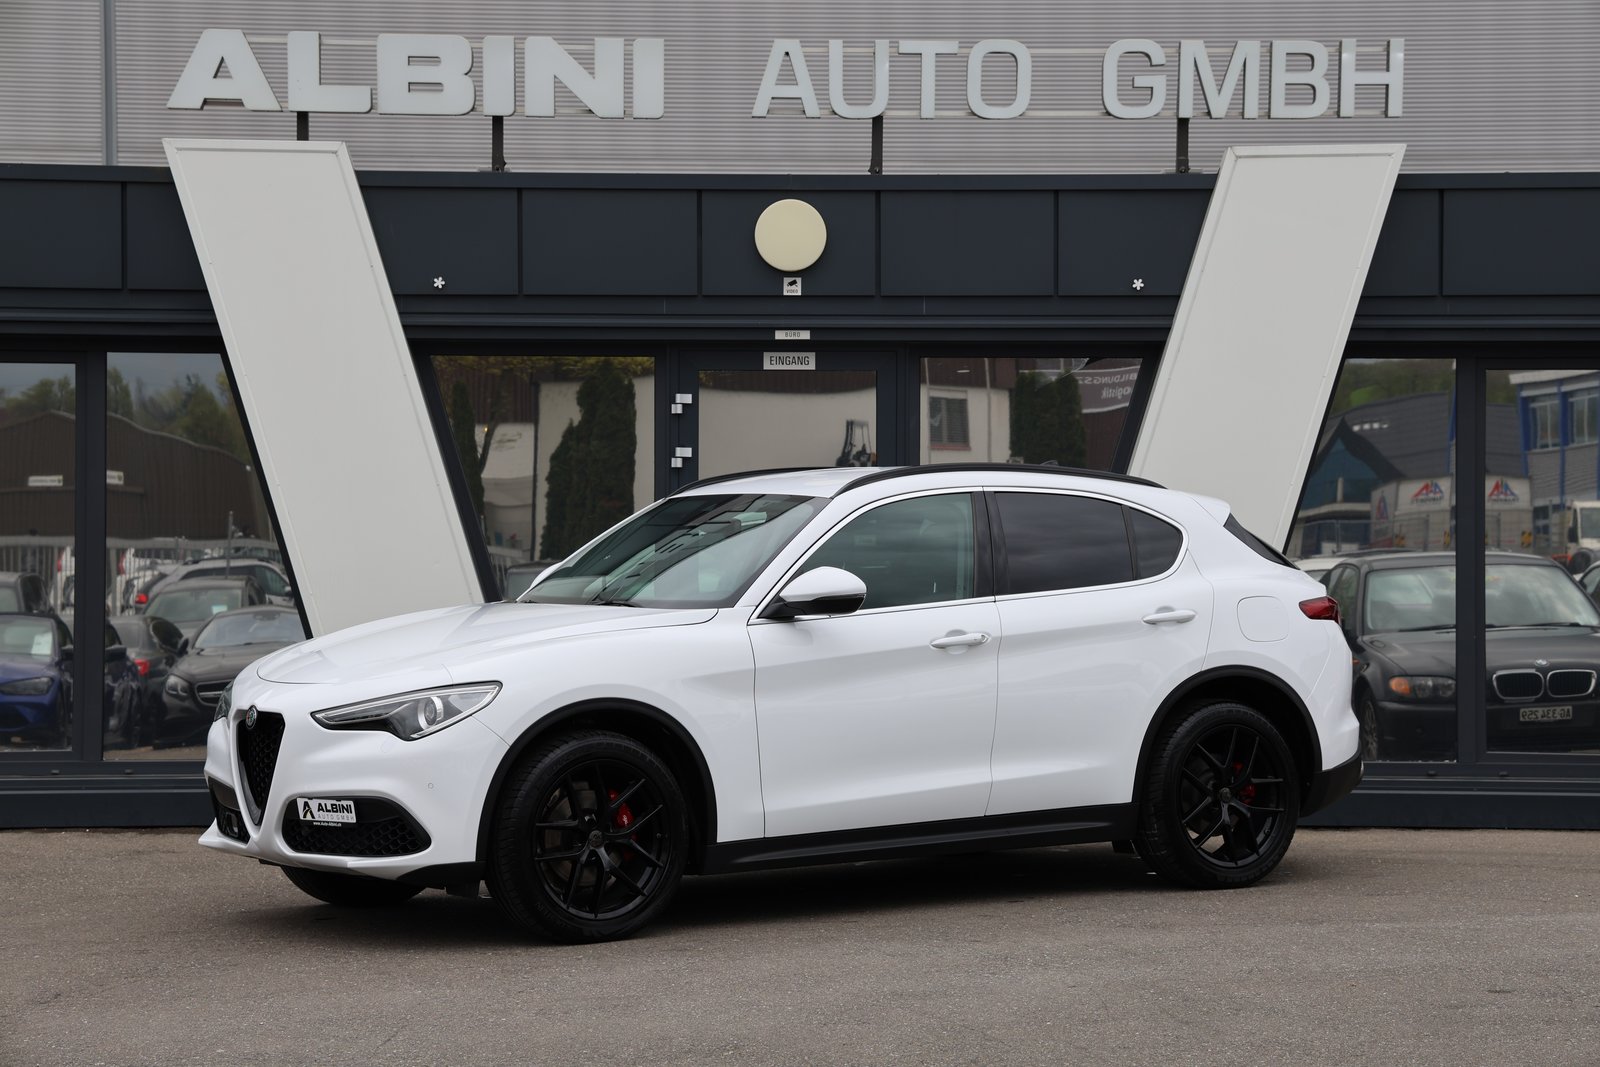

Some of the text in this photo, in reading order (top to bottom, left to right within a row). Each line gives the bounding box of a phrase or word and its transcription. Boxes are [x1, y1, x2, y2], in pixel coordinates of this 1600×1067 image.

[167, 28, 1405, 120] ALBINI AUTO GMBH
[769, 355, 810, 366] EINGANG
[317, 803, 353, 814] ALBINI
